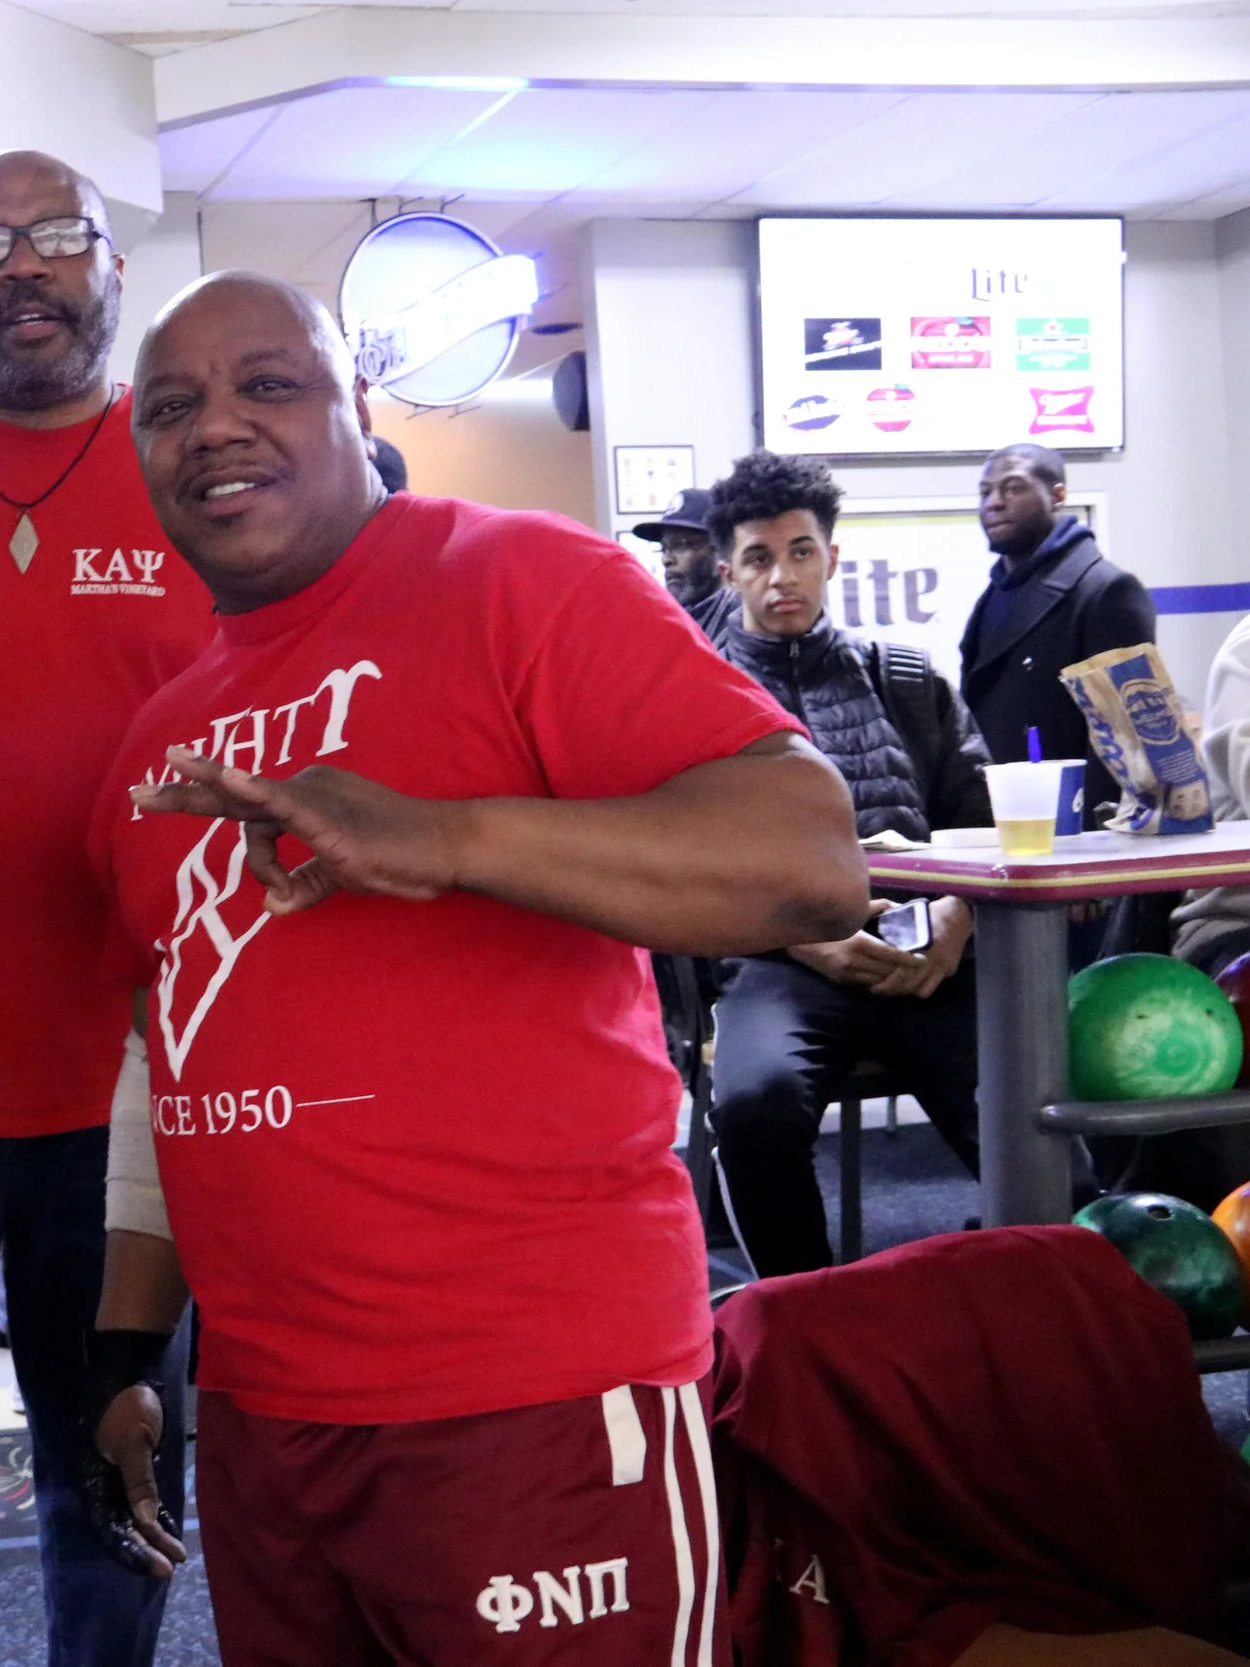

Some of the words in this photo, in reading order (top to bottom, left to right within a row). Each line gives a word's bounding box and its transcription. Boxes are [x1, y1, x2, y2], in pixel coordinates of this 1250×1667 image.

[839, 559, 938, 628] ite
[200, 1085, 293, 1135] 1950
[476, 1557, 630, 1633] ΦΝΠ
